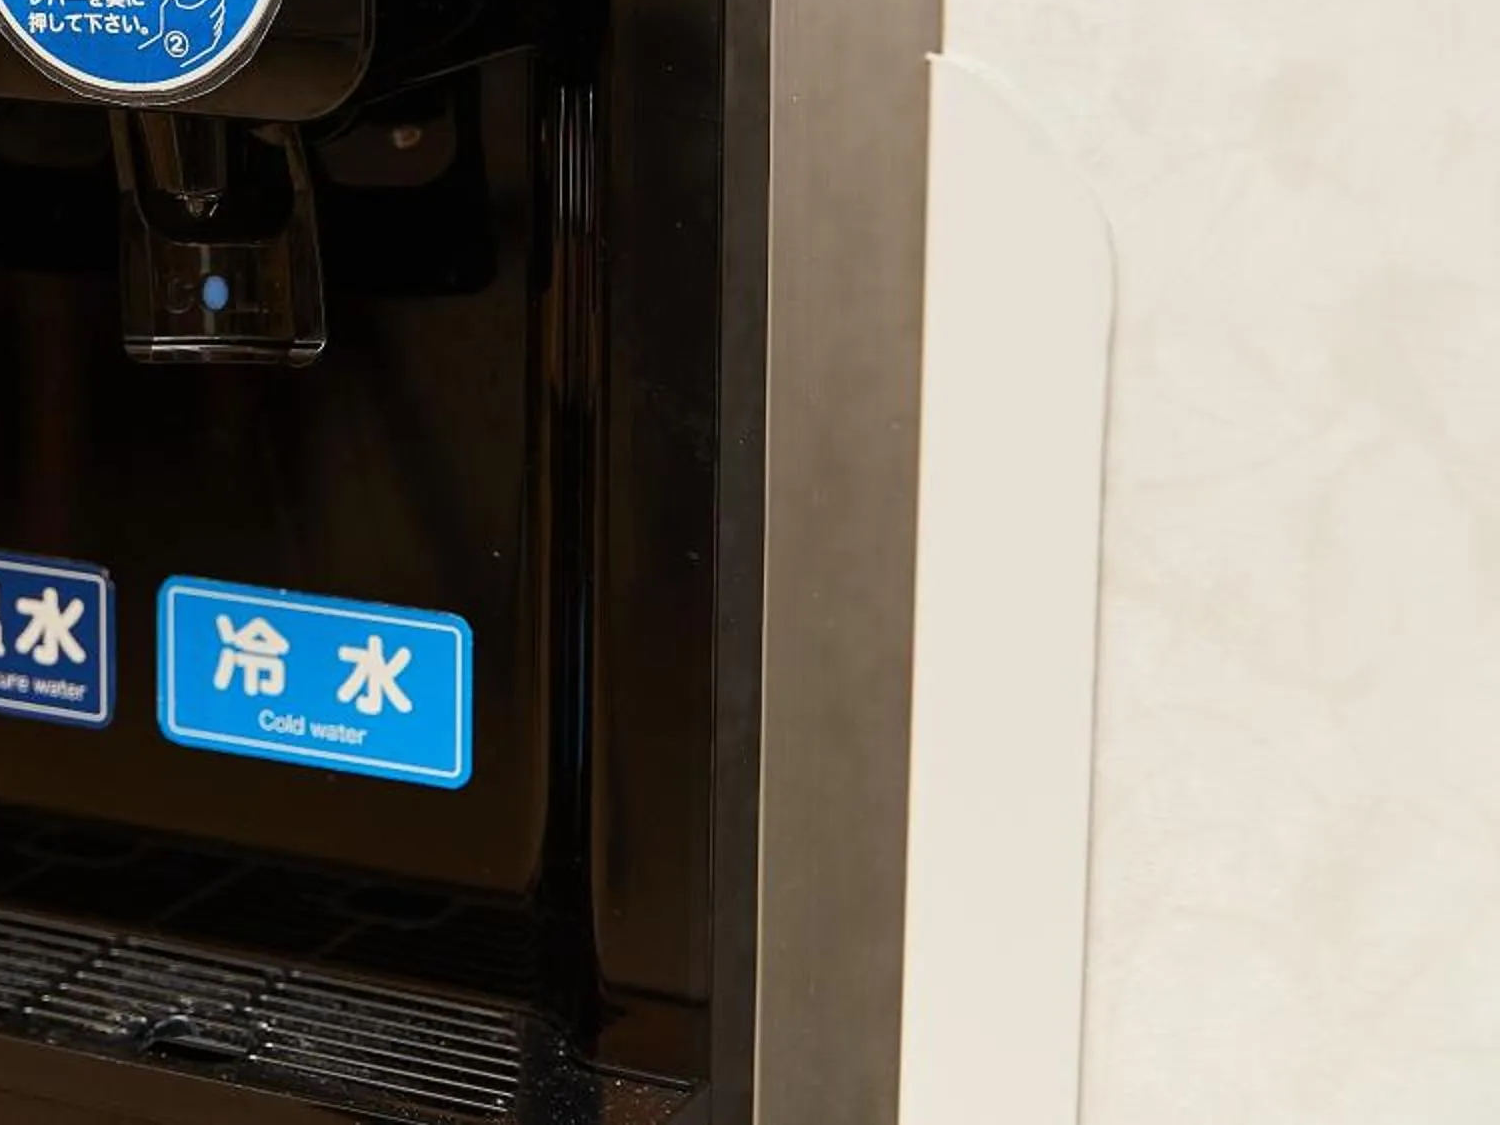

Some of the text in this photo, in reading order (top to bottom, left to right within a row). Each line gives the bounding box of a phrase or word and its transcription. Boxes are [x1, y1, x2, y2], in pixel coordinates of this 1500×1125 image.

[28, 11, 150, 36] 押して下さい。
[32, 677, 88, 701] water
[257, 709, 368, 747] Cold water
